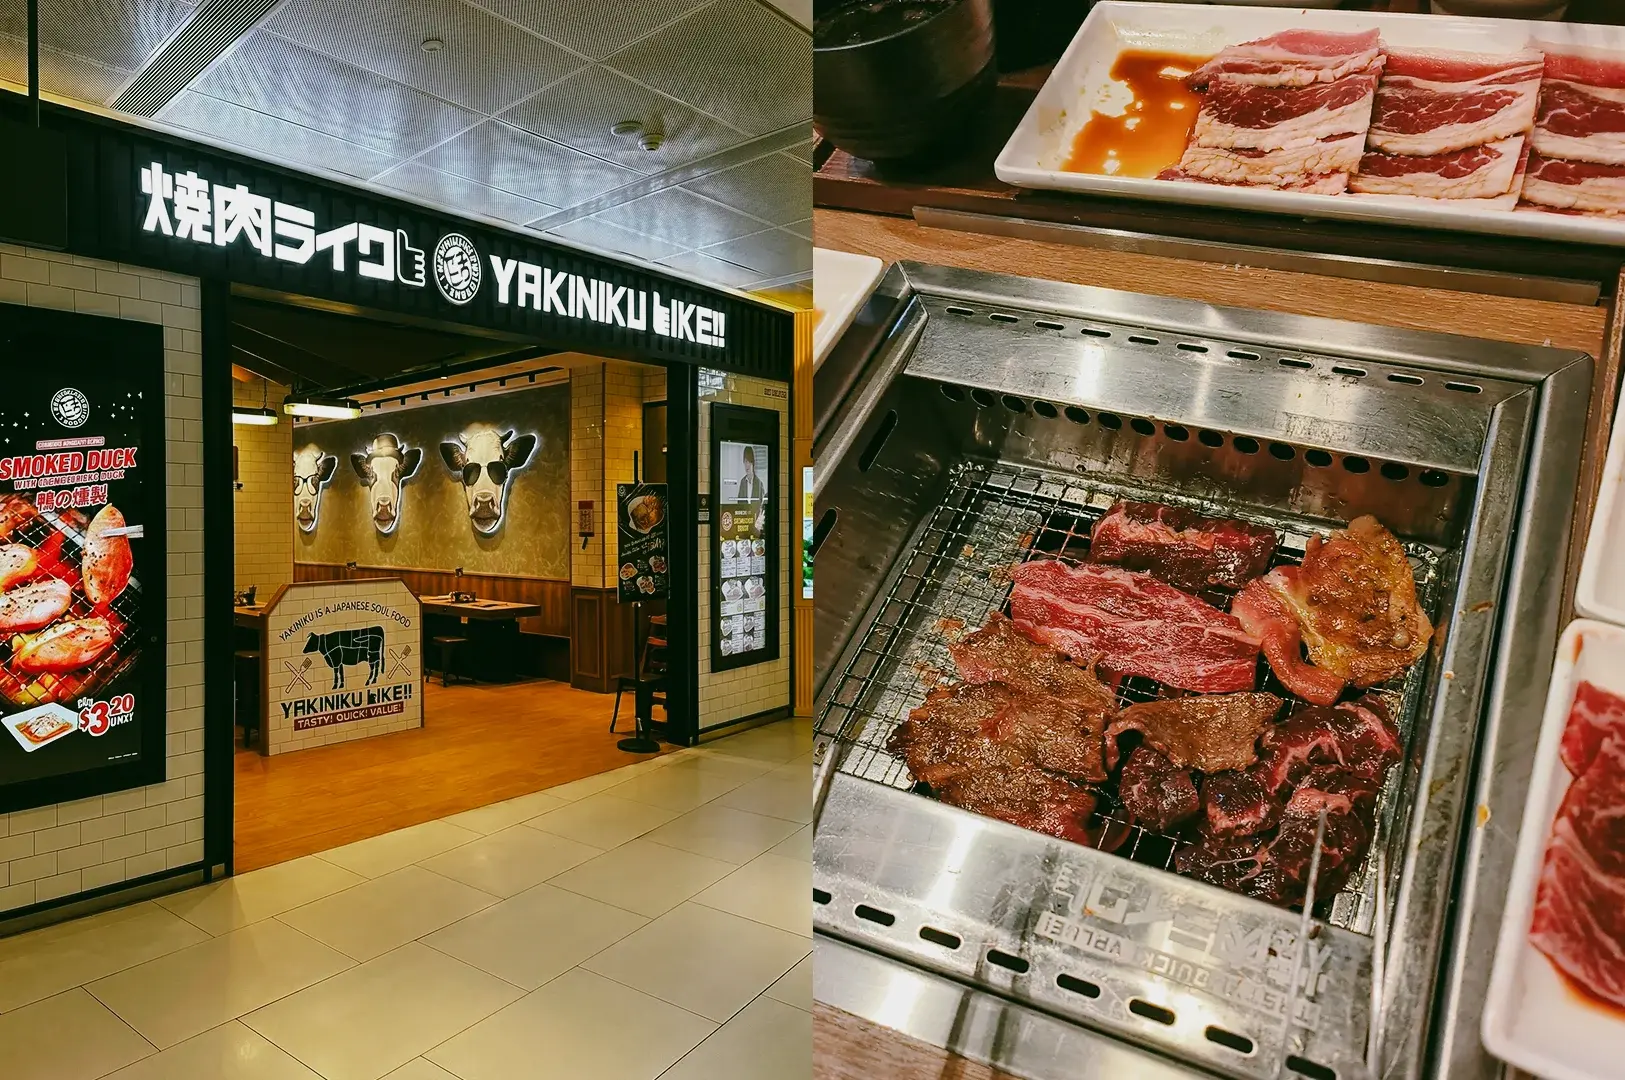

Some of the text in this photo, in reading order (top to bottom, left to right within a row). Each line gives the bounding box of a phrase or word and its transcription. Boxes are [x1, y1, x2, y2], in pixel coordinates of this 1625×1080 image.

[490, 255, 647, 332] YAKINIKU
[0, 447, 138, 480] SMOKED DUCK
[14, 479, 37, 490] WITH
[278, 601, 412, 642] YAKINIKU IS A JAPANESE SOUL FOOD
[280, 691, 363, 719] YAKINIKU
[297, 715, 334, 729] TASTY!
[370, 703, 402, 717] VALUE!
